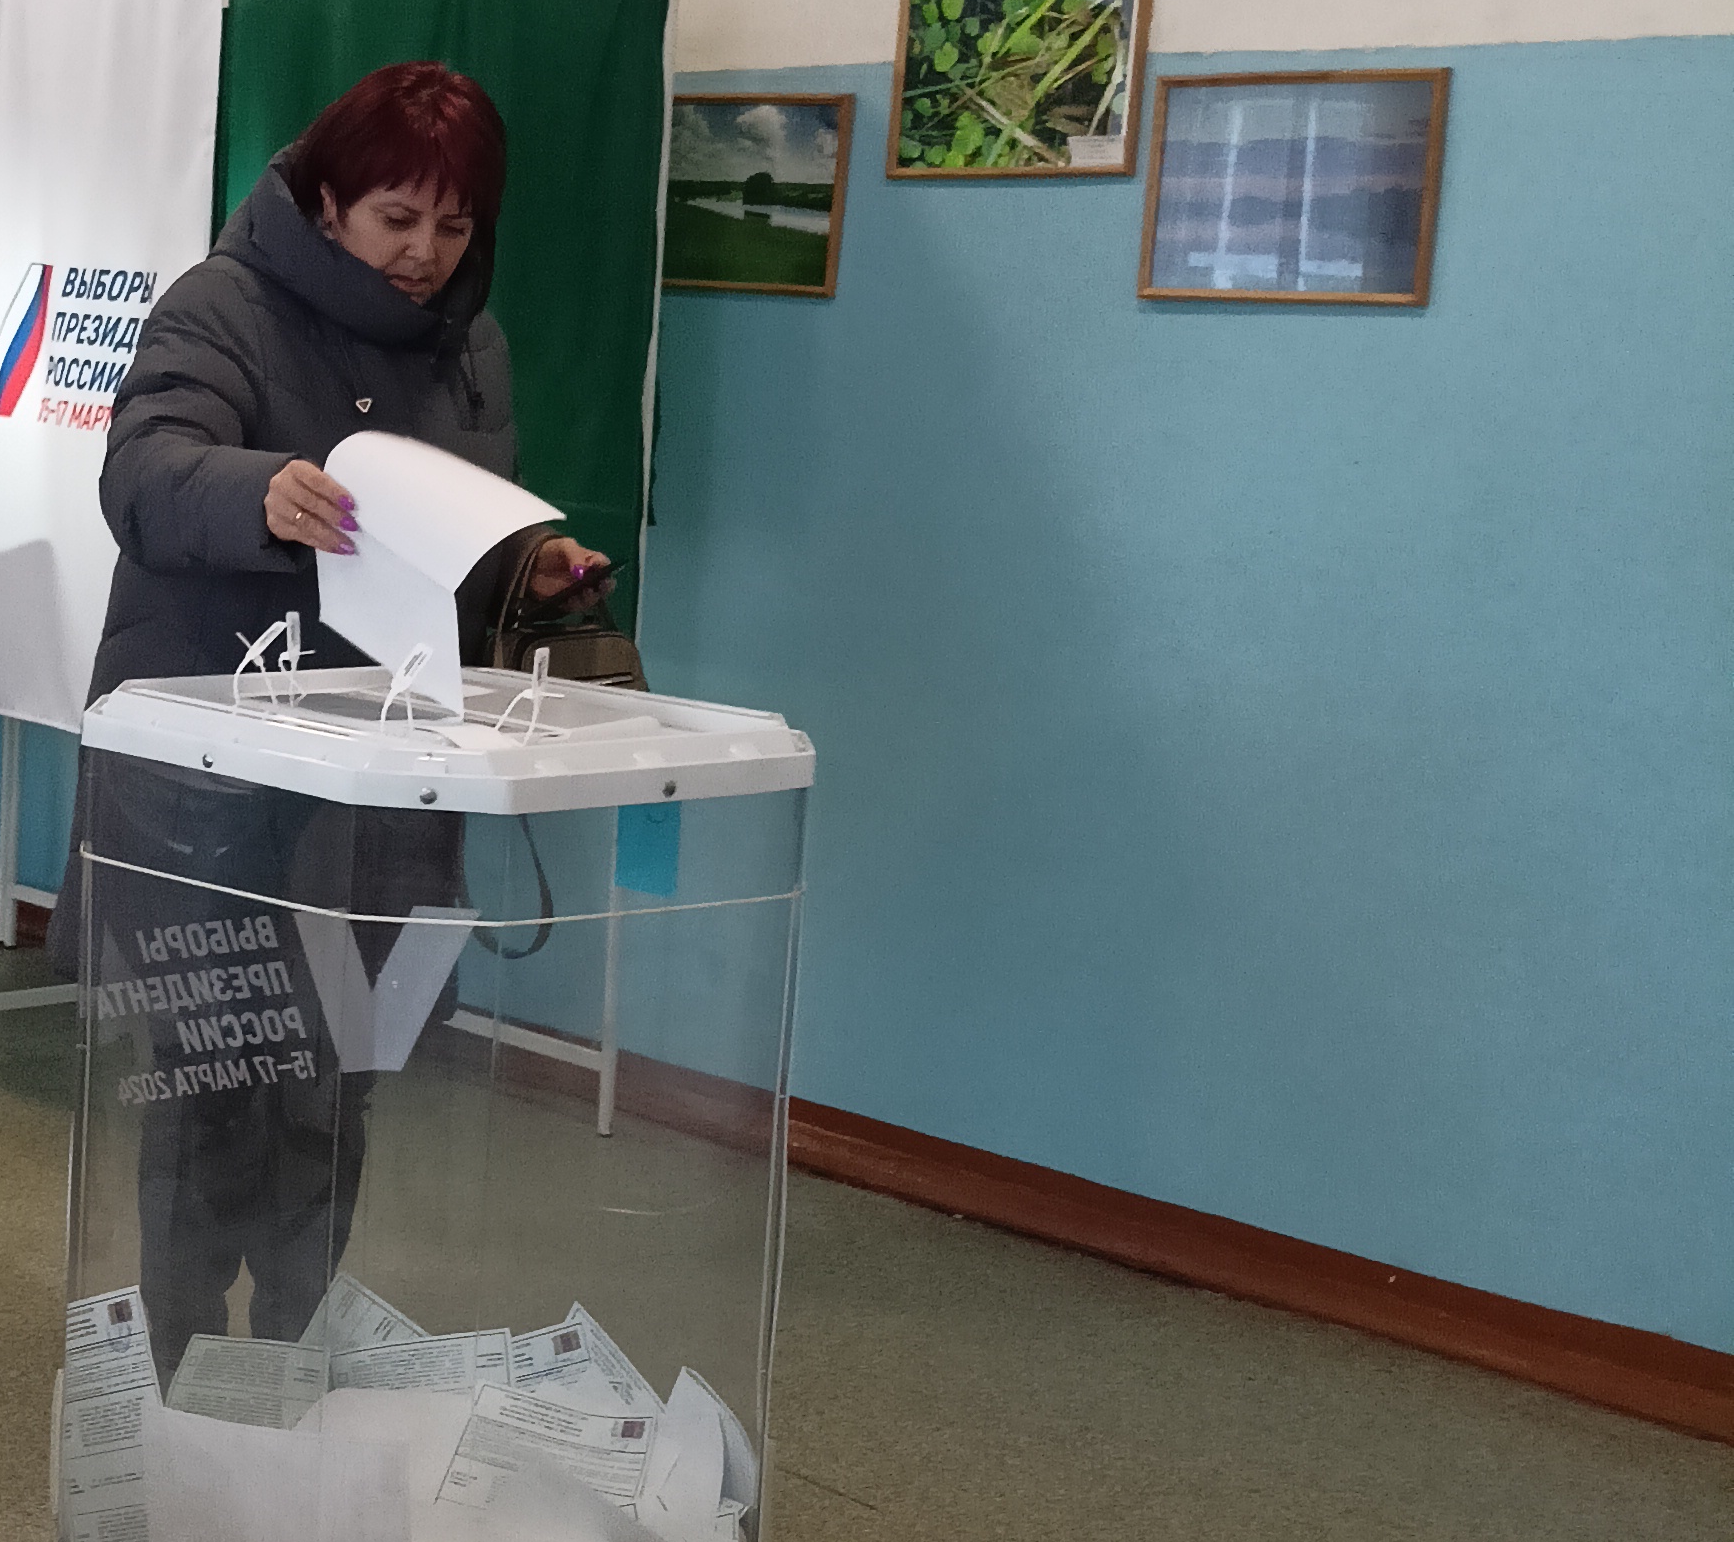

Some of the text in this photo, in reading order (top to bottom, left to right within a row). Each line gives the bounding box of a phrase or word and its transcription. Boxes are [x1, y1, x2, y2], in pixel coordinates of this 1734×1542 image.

[61, 267, 158, 304] ВЫБОРЫ
[51, 311, 141, 355] ПРЕЗИД
[45, 355, 128, 394] РОССИИ
[67, 401, 114, 433] МАРТ
